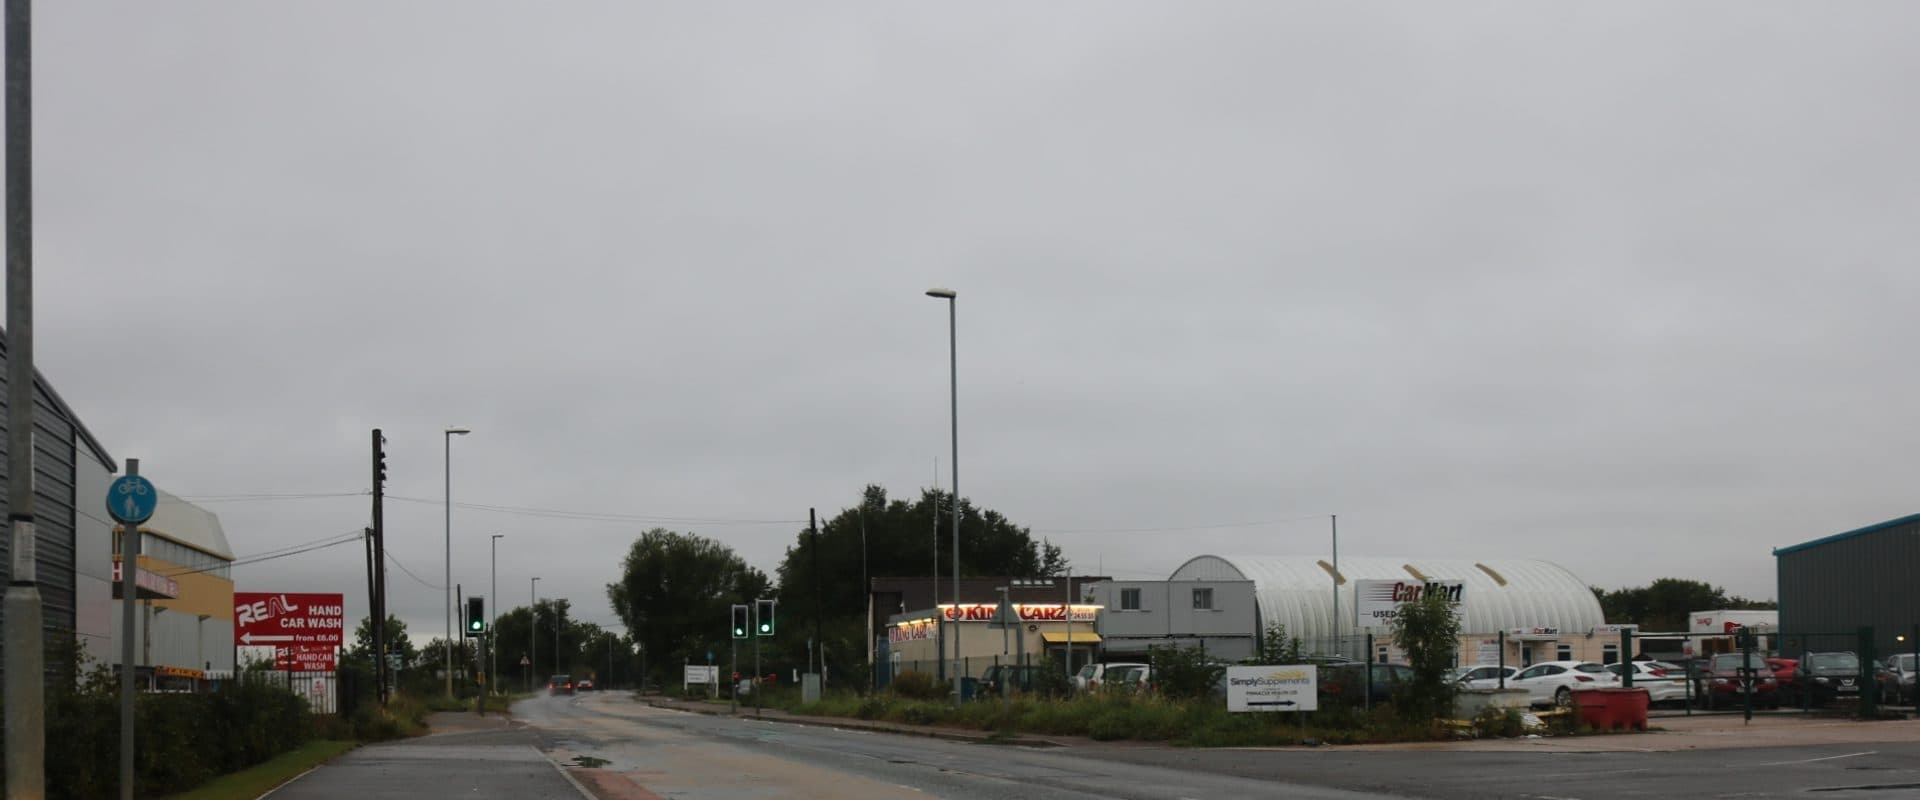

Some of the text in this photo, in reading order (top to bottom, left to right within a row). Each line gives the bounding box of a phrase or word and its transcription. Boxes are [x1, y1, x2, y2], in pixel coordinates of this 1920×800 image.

[236, 594, 298, 627] REAL
[308, 605, 341, 616] HAND
[966, 606, 1066, 620] KIN CARZ
[1372, 610, 1396, 618] USED
[280, 618, 341, 628] CAR WASH
[296, 653, 332, 661] HAND CAR
